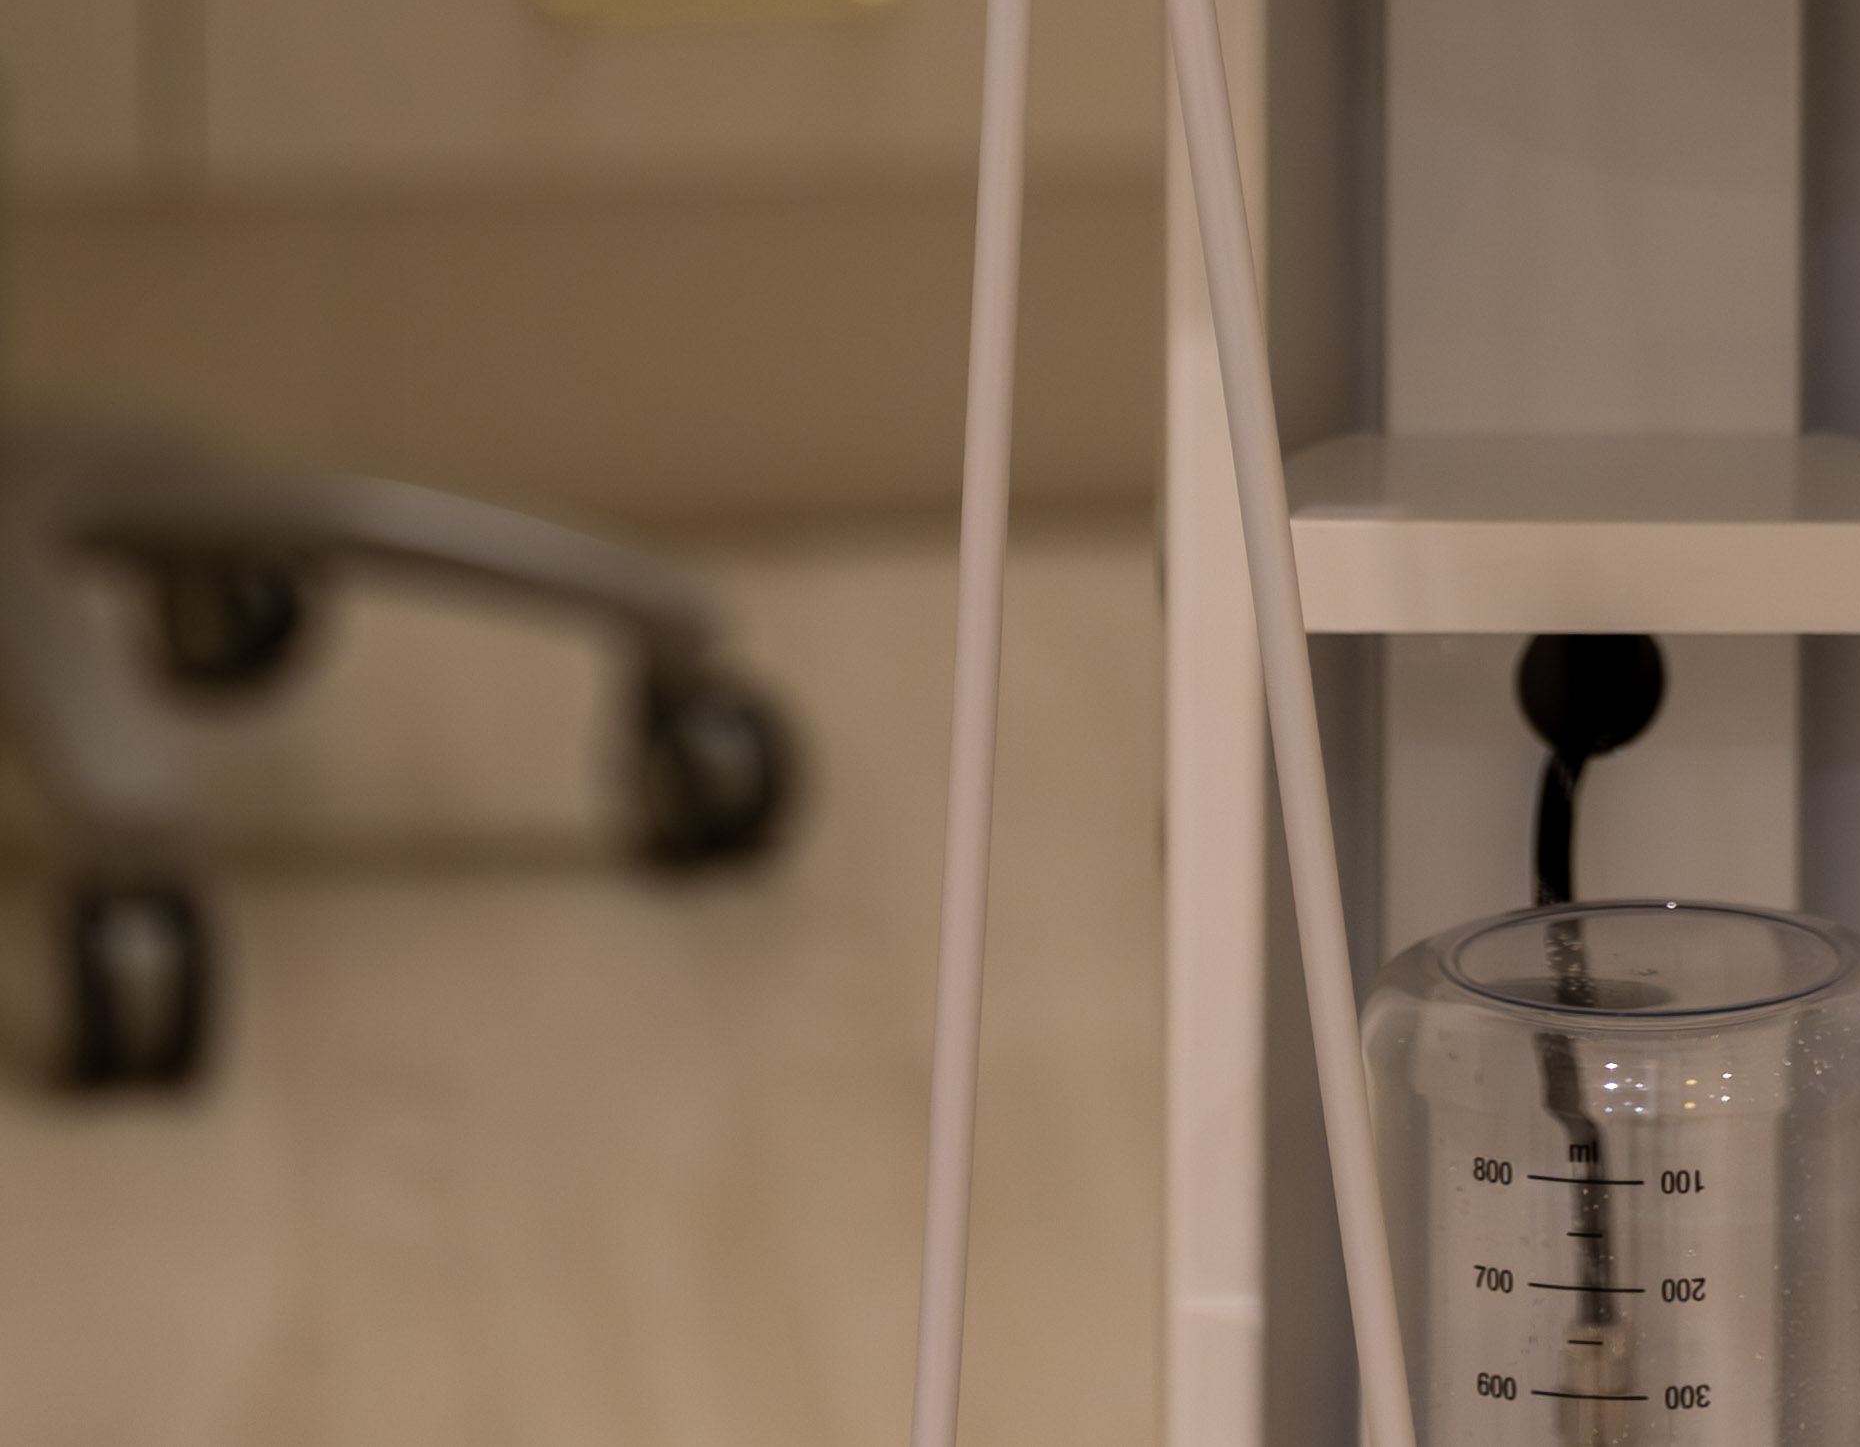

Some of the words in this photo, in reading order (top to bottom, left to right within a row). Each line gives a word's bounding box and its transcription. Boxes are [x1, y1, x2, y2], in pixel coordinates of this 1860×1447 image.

[1473, 1157, 1512, 1186] 800
[1660, 1169, 1705, 1194] 100
[1473, 1265, 1513, 1293] 700
[1660, 1277, 1706, 1303] 200
[1476, 1373, 1517, 1401] 600
[1664, 1384, 1711, 1410] 300
